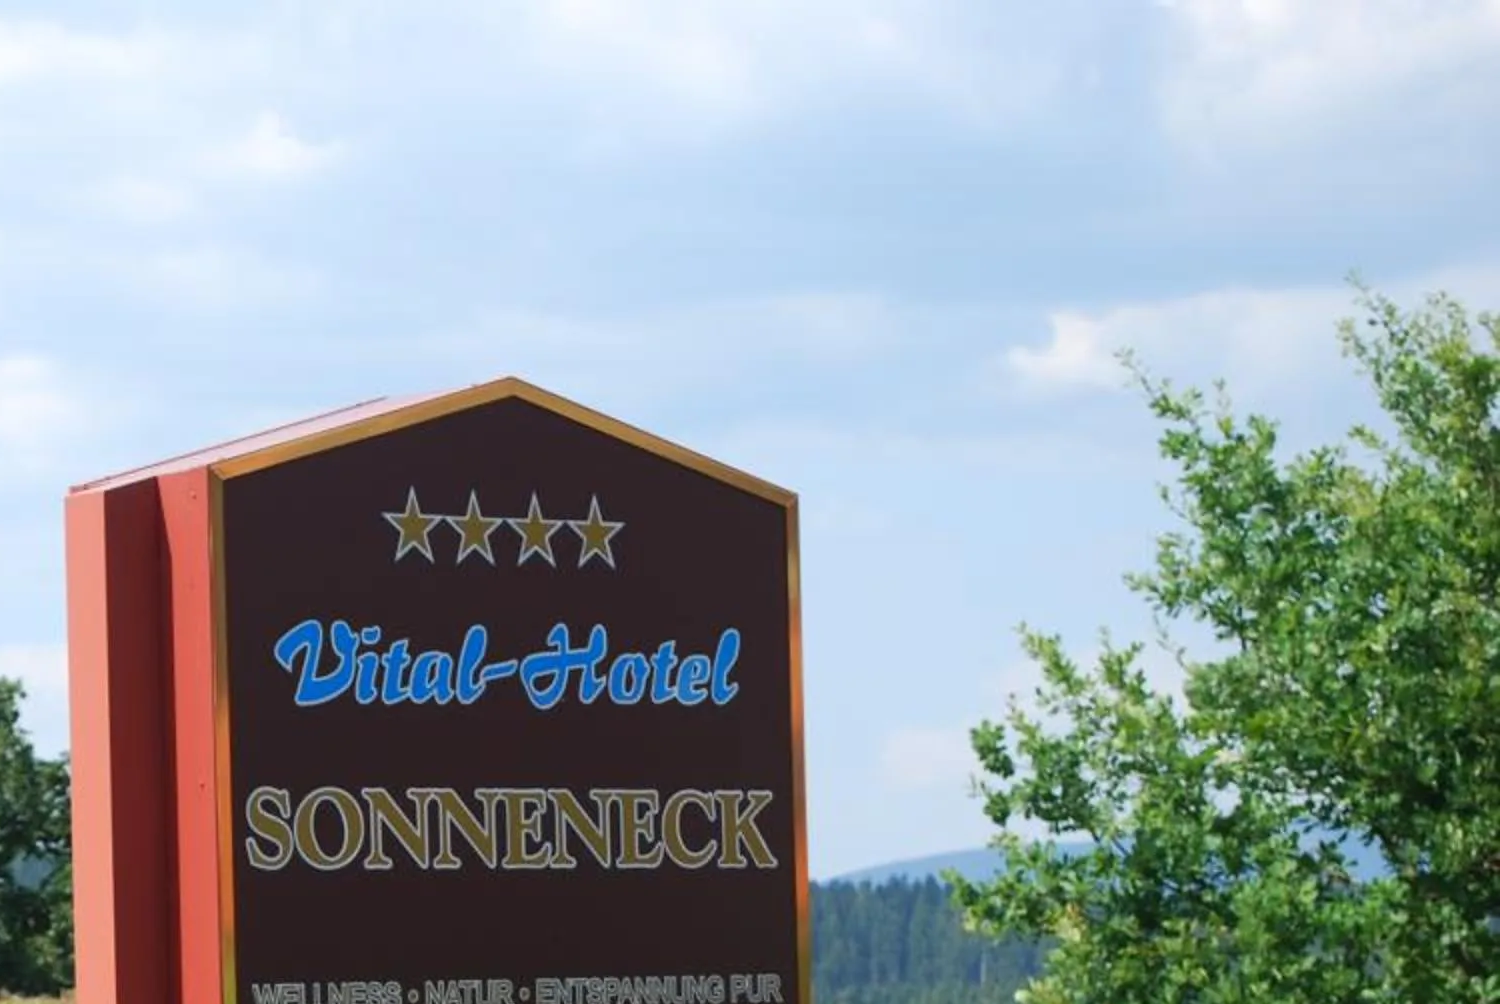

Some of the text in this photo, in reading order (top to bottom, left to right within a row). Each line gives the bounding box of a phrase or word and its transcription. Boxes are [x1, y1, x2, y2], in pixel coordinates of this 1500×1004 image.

[274, 618, 741, 710] Vital-Hotel
[245, 785, 778, 871] SONNENECK
[729, 973, 784, 1004] PUR
